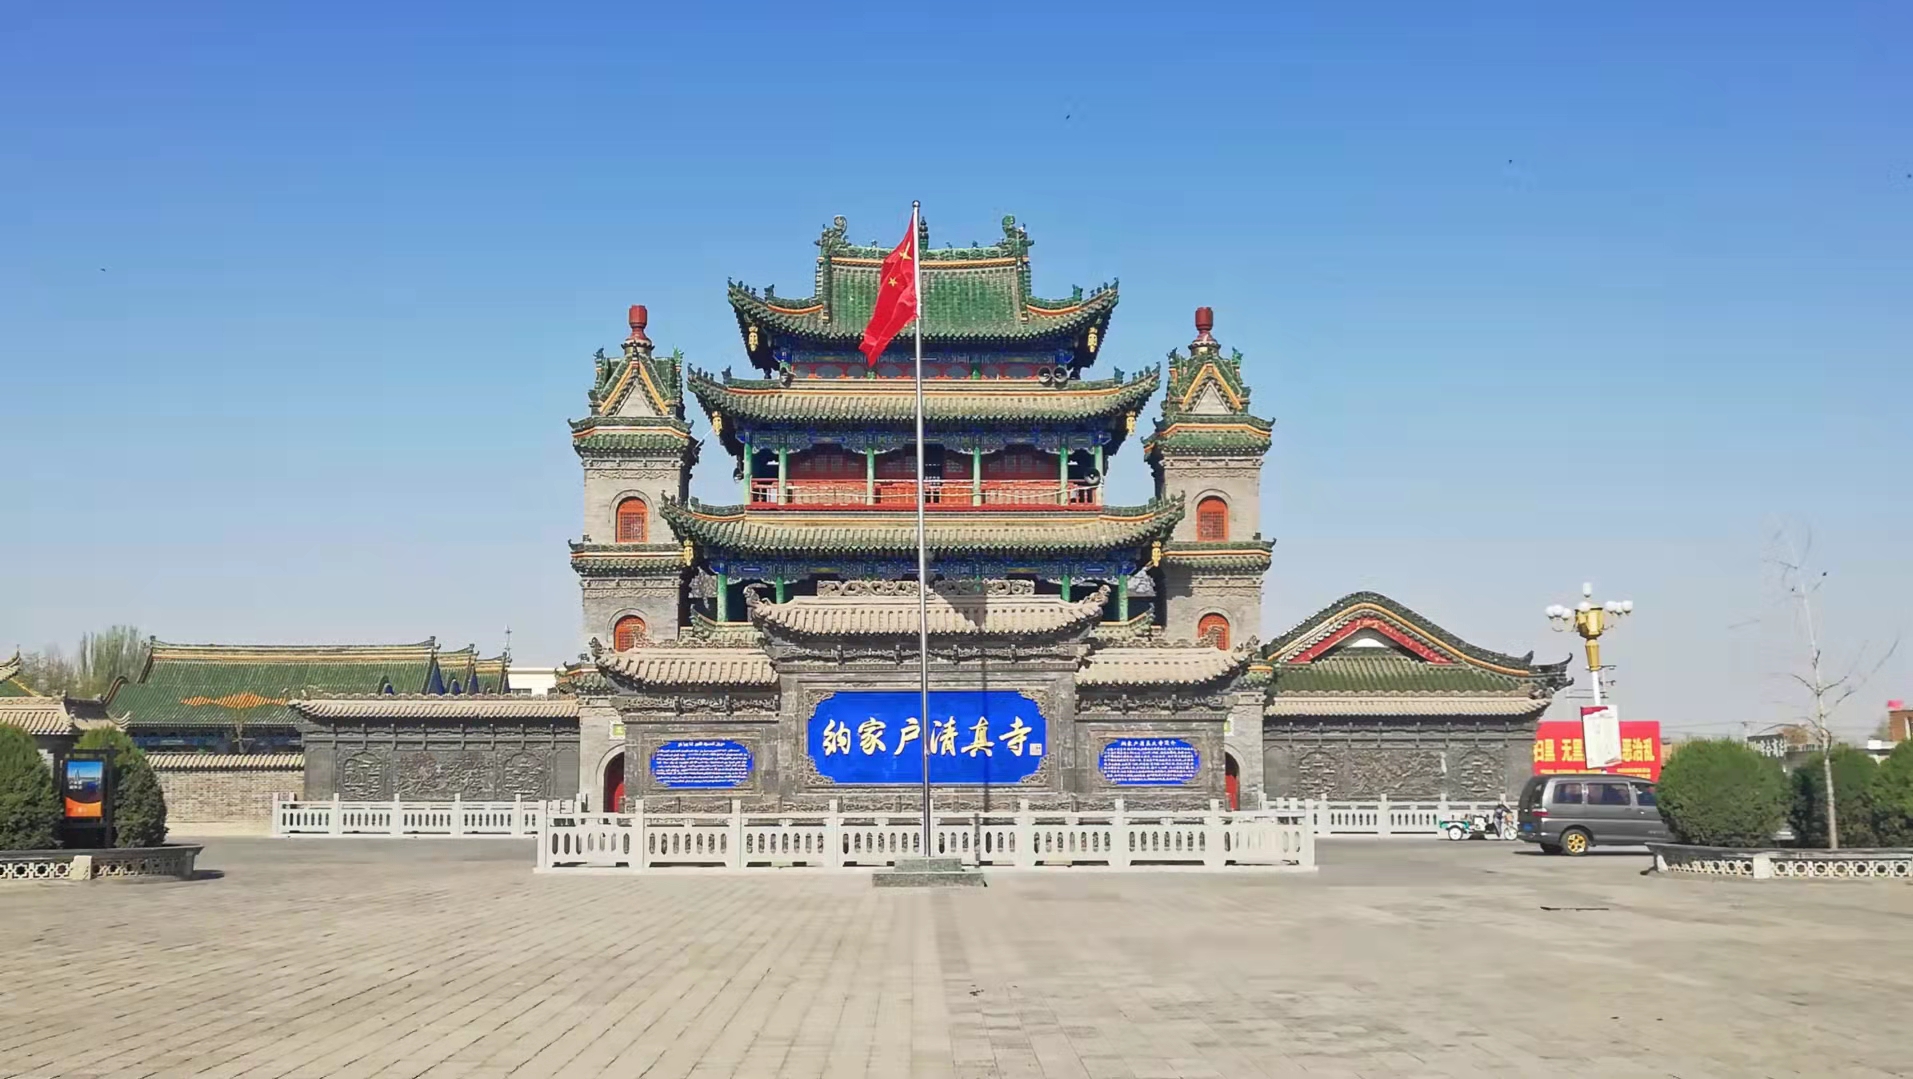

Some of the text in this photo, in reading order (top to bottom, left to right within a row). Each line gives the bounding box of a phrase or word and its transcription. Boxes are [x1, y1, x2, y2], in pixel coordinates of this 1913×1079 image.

[822, 716, 1033, 757] 纳家户清真寺
